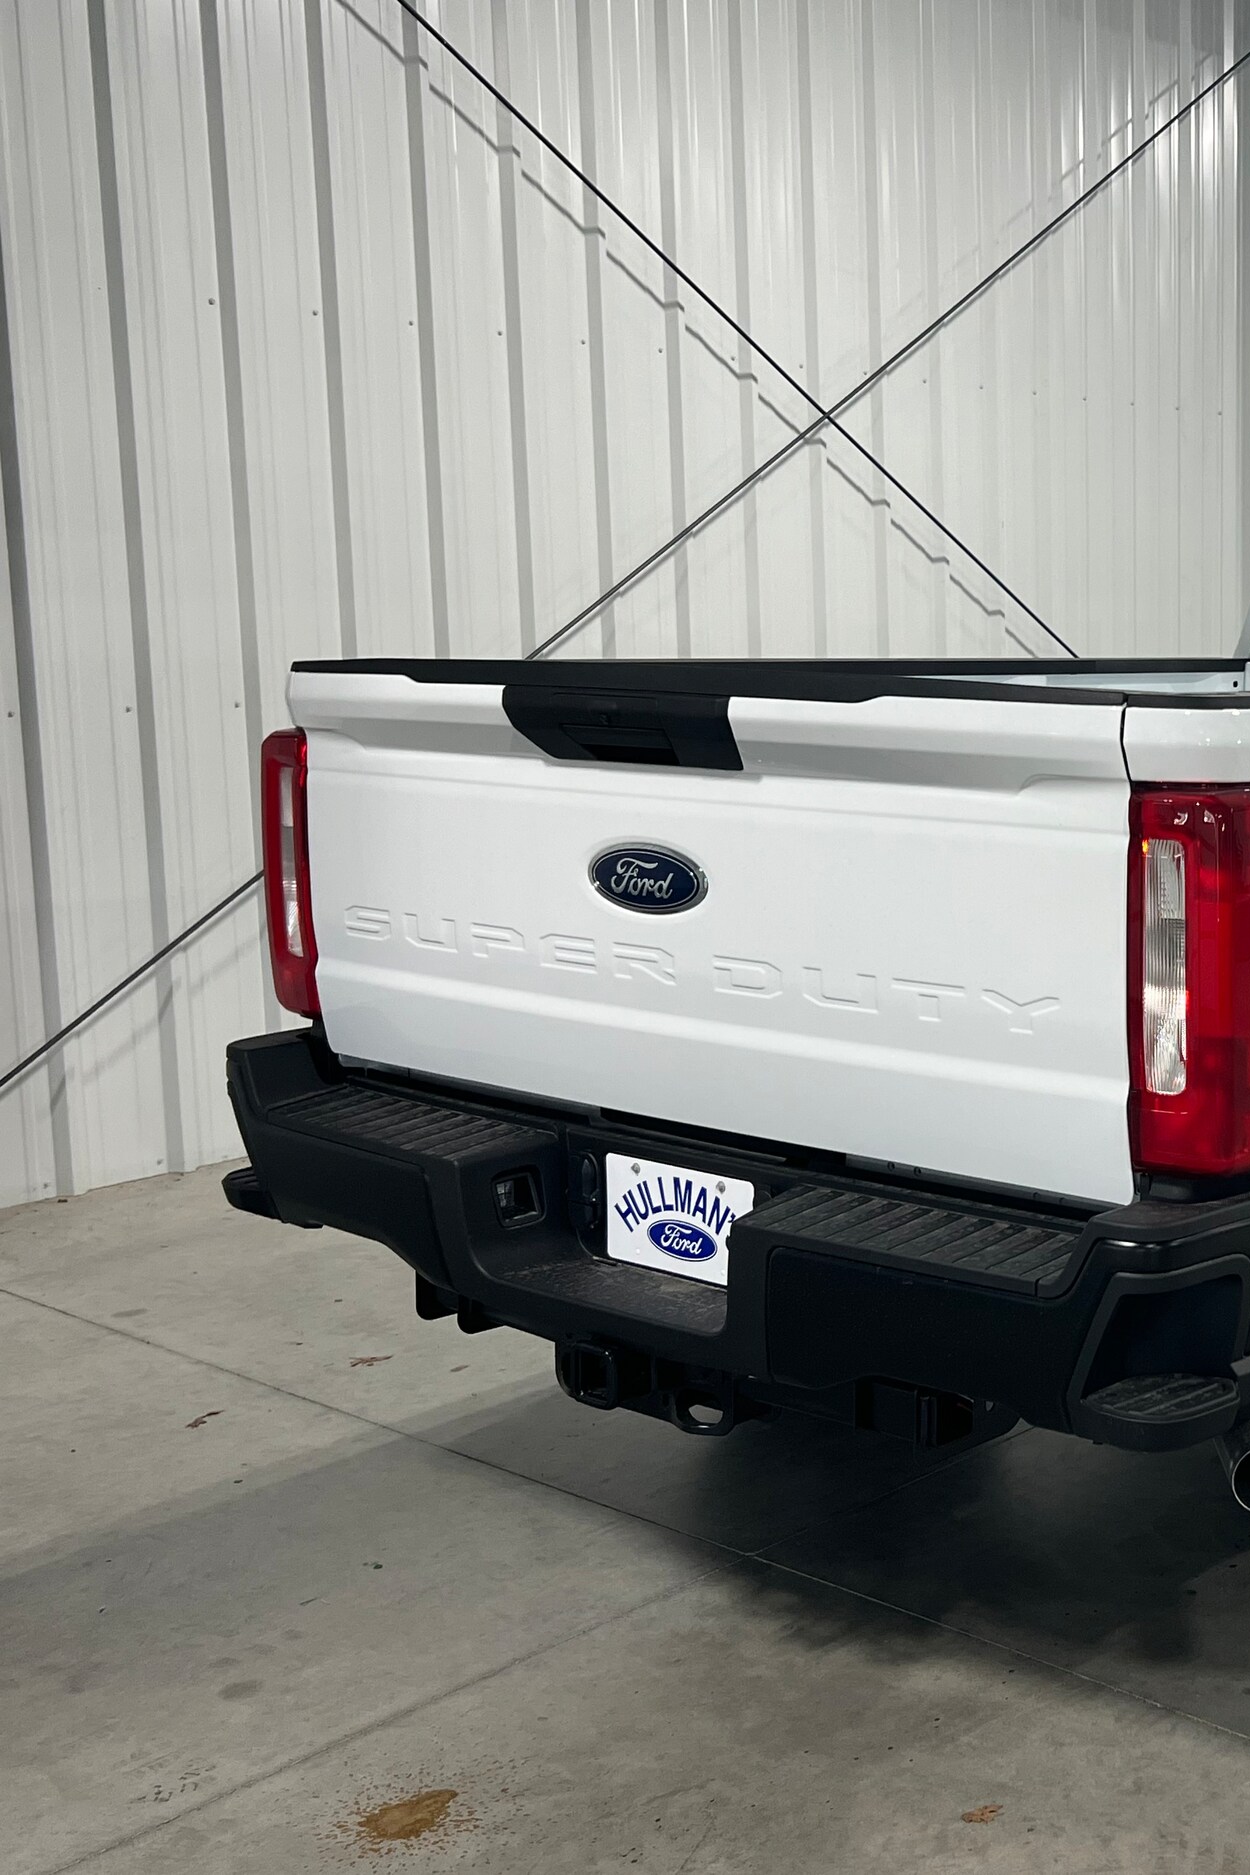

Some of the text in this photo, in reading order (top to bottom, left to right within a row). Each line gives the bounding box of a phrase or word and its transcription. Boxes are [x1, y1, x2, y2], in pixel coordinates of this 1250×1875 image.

[611, 857, 675, 899] Ford
[344, 904, 1062, 1035] SUPER DUTY
[614, 1176, 736, 1236] HULLMAN'
[660, 1224, 702, 1255] Ford
